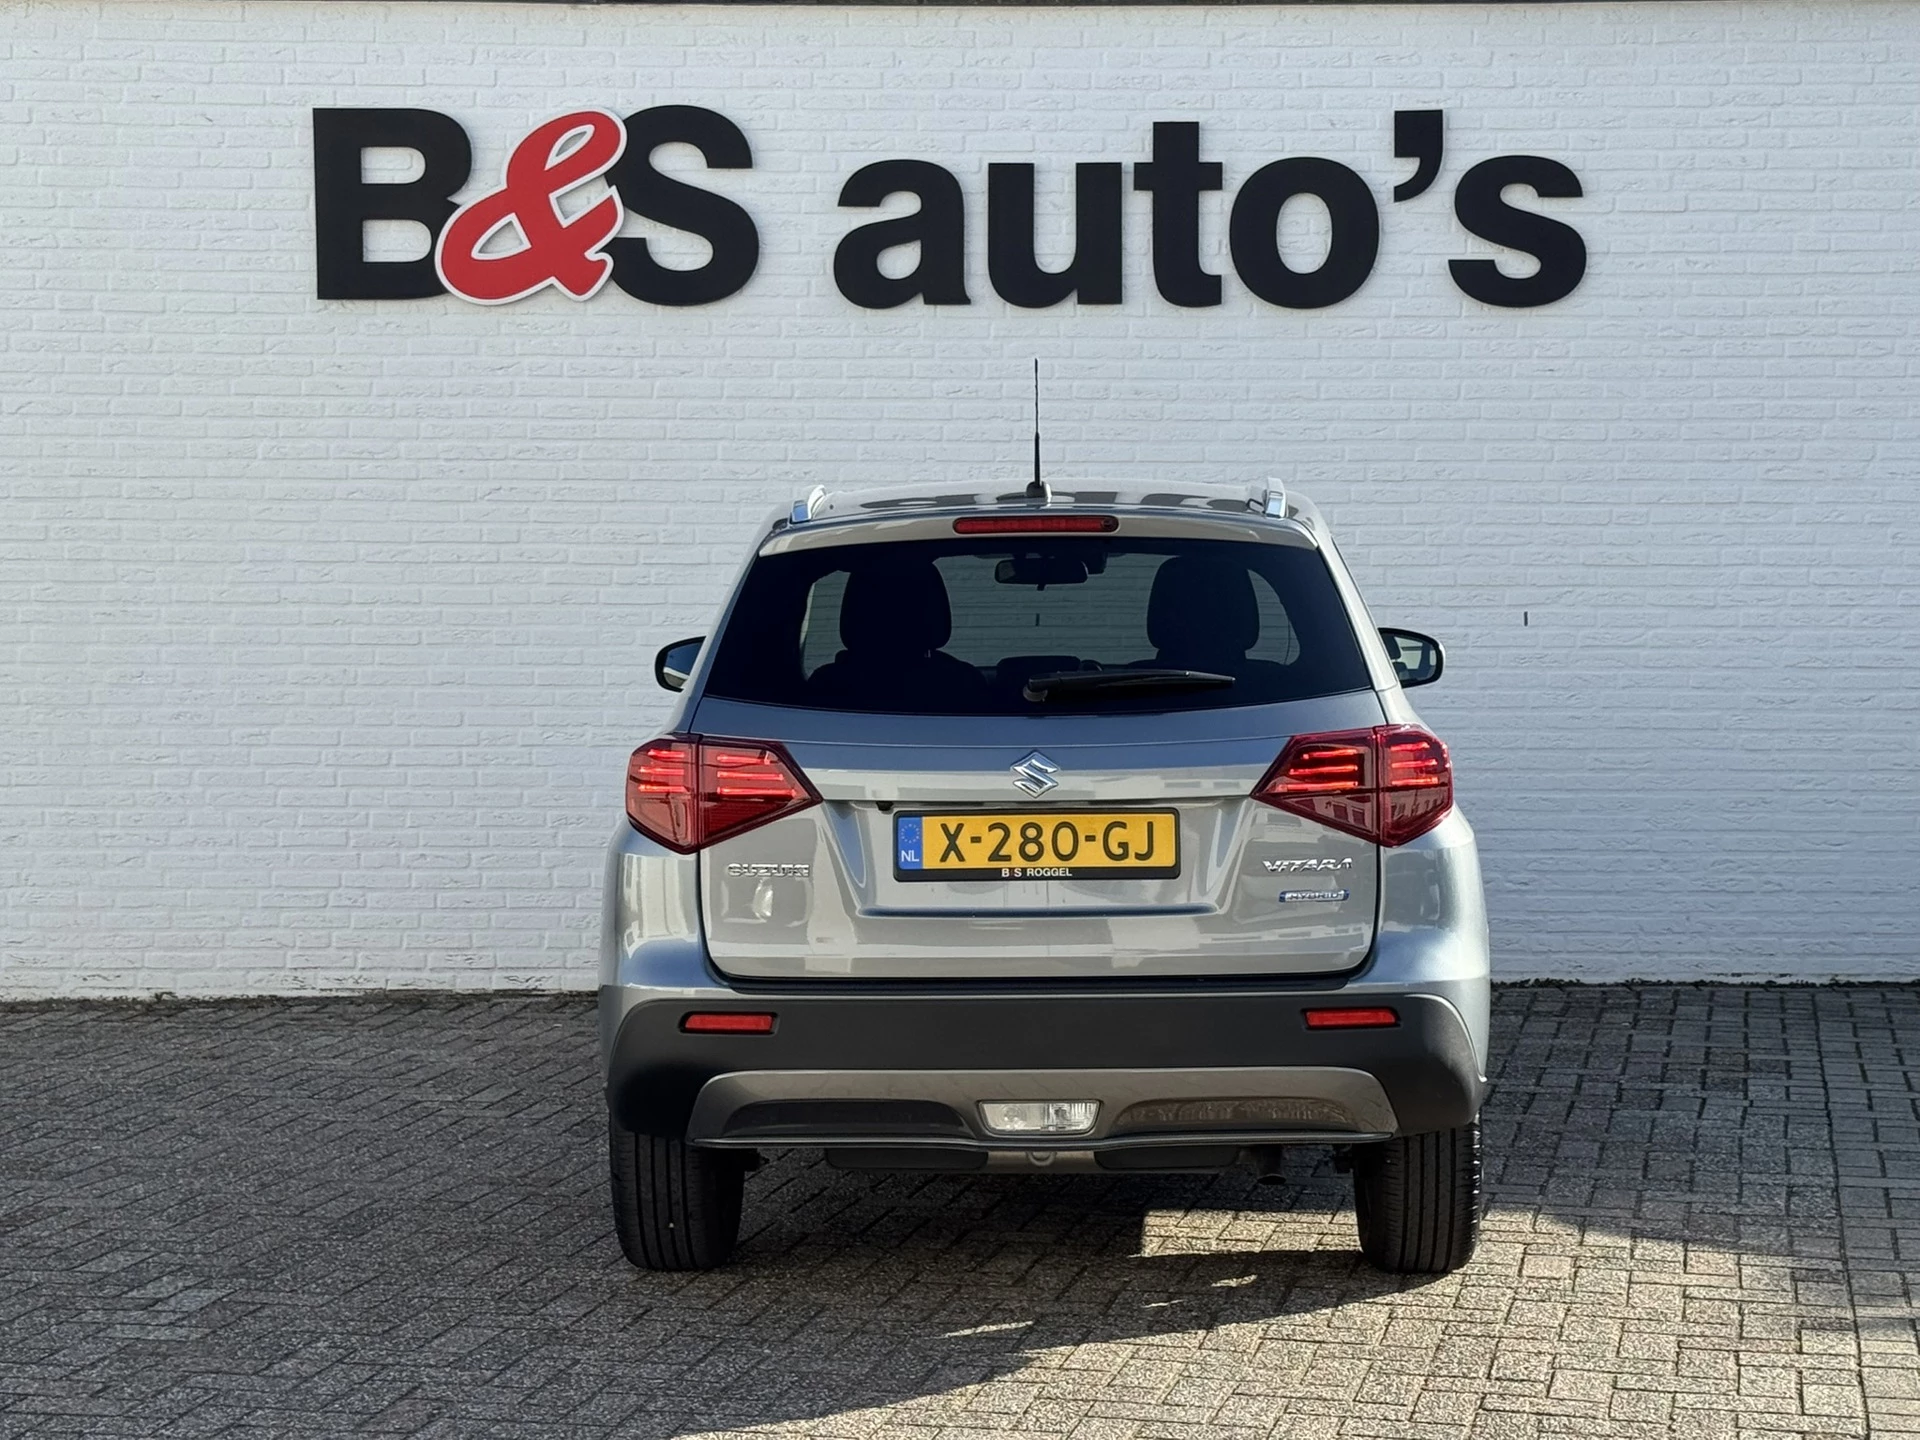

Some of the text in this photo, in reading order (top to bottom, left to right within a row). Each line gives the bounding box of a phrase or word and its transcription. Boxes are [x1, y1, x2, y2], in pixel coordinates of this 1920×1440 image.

[312, 104, 1587, 310] B&S auto's
[938, 820, 1155, 863] X-280-GJ
[900, 850, 920, 863] NL
[727, 862, 810, 877] SUZUKI
[1026, 867, 1073, 877] ROGGEL
[1262, 857, 1353, 873] VITARA
